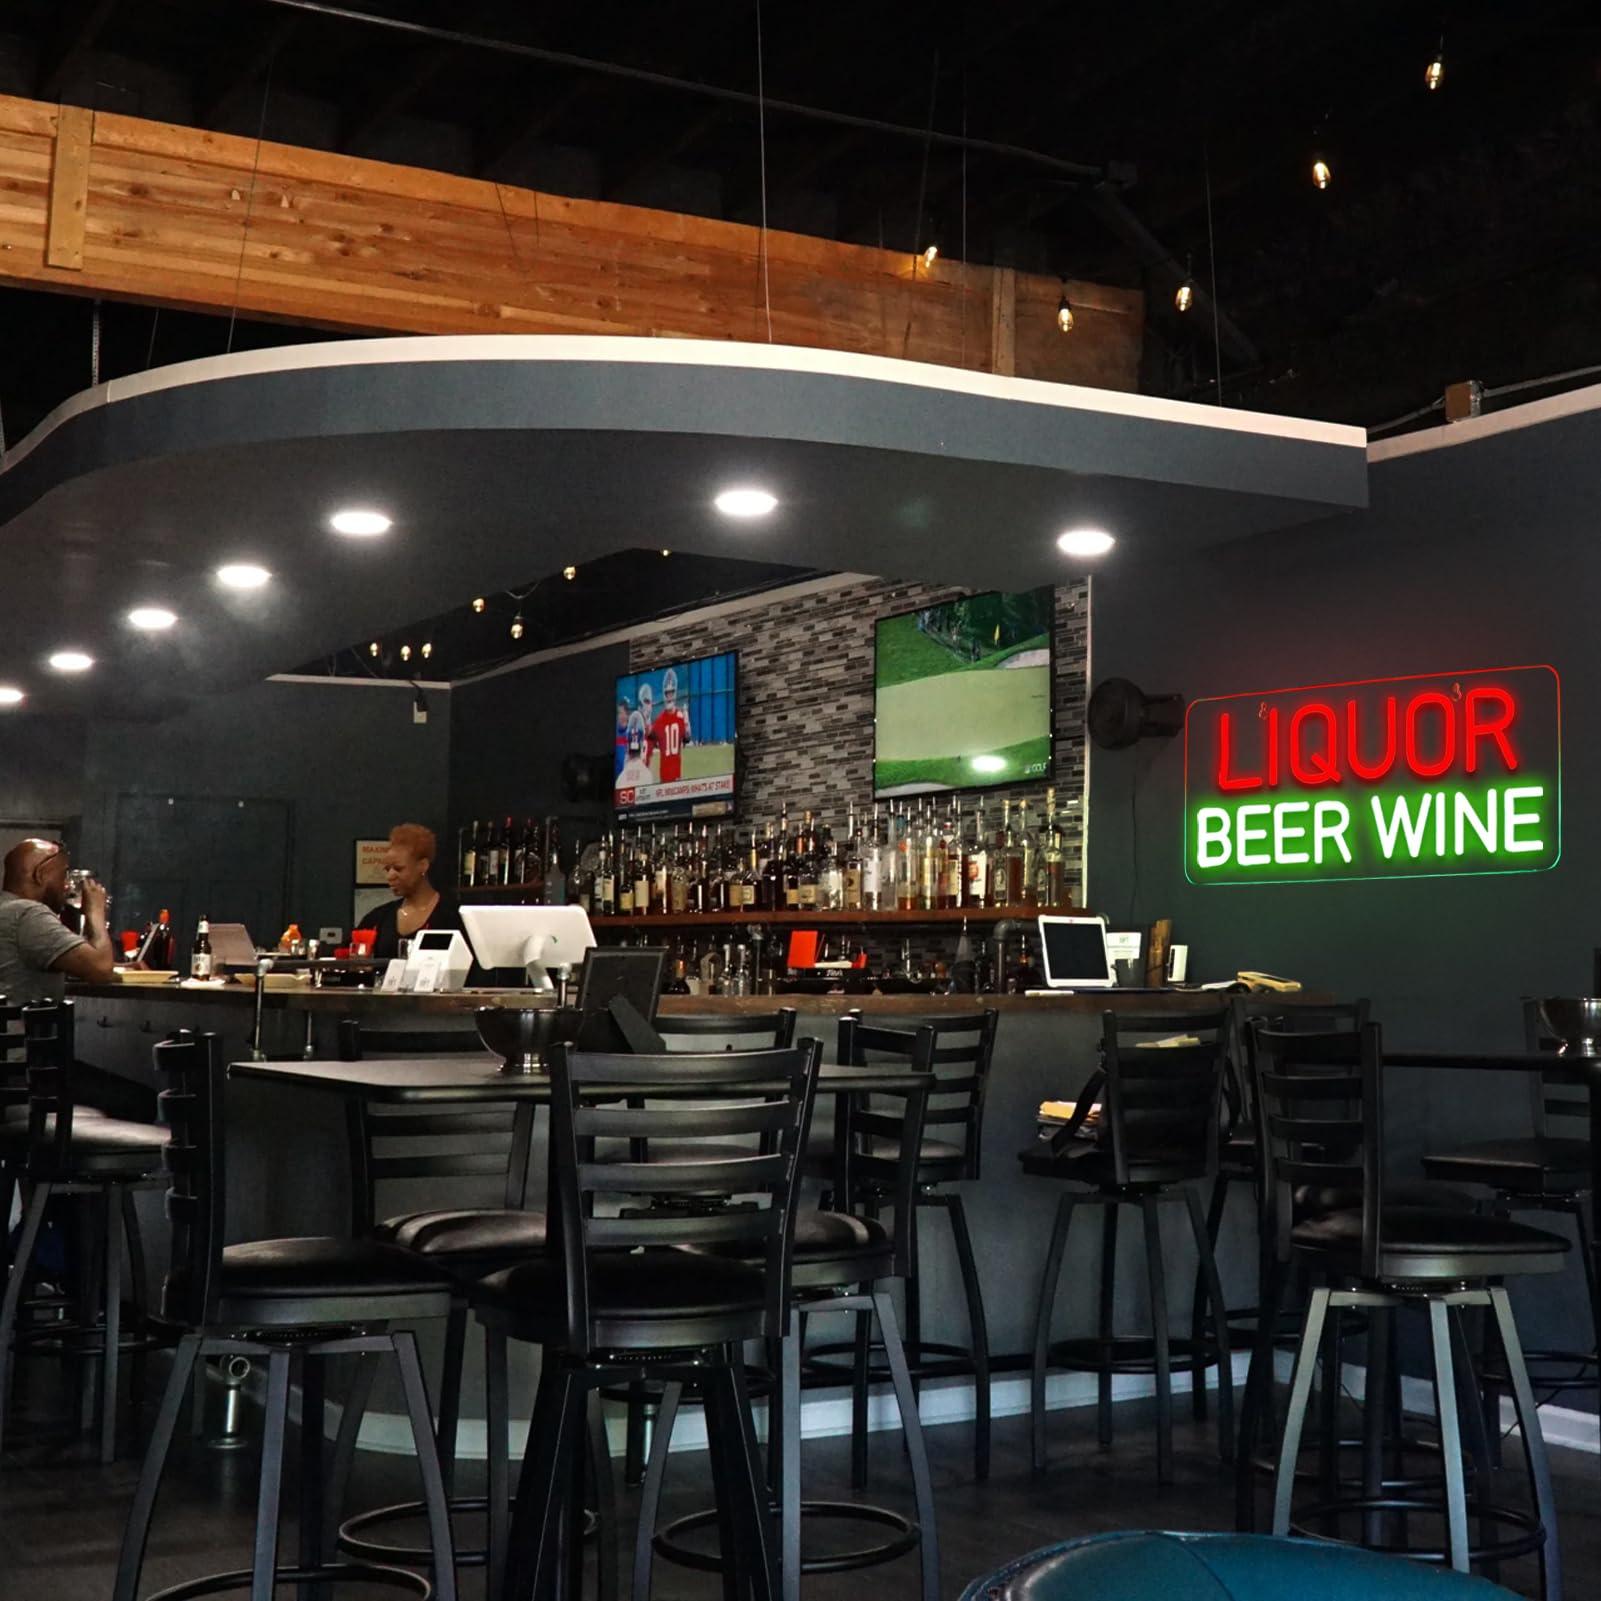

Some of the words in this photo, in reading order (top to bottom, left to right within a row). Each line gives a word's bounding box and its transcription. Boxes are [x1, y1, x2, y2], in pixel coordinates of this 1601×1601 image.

[665, 723, 679, 756] 10
[1218, 687, 1518, 791] LIQUOR
[620, 790, 634, 804] SC
[1196, 800, 1352, 868] BEER
[1370, 786, 1544, 859] WINE
